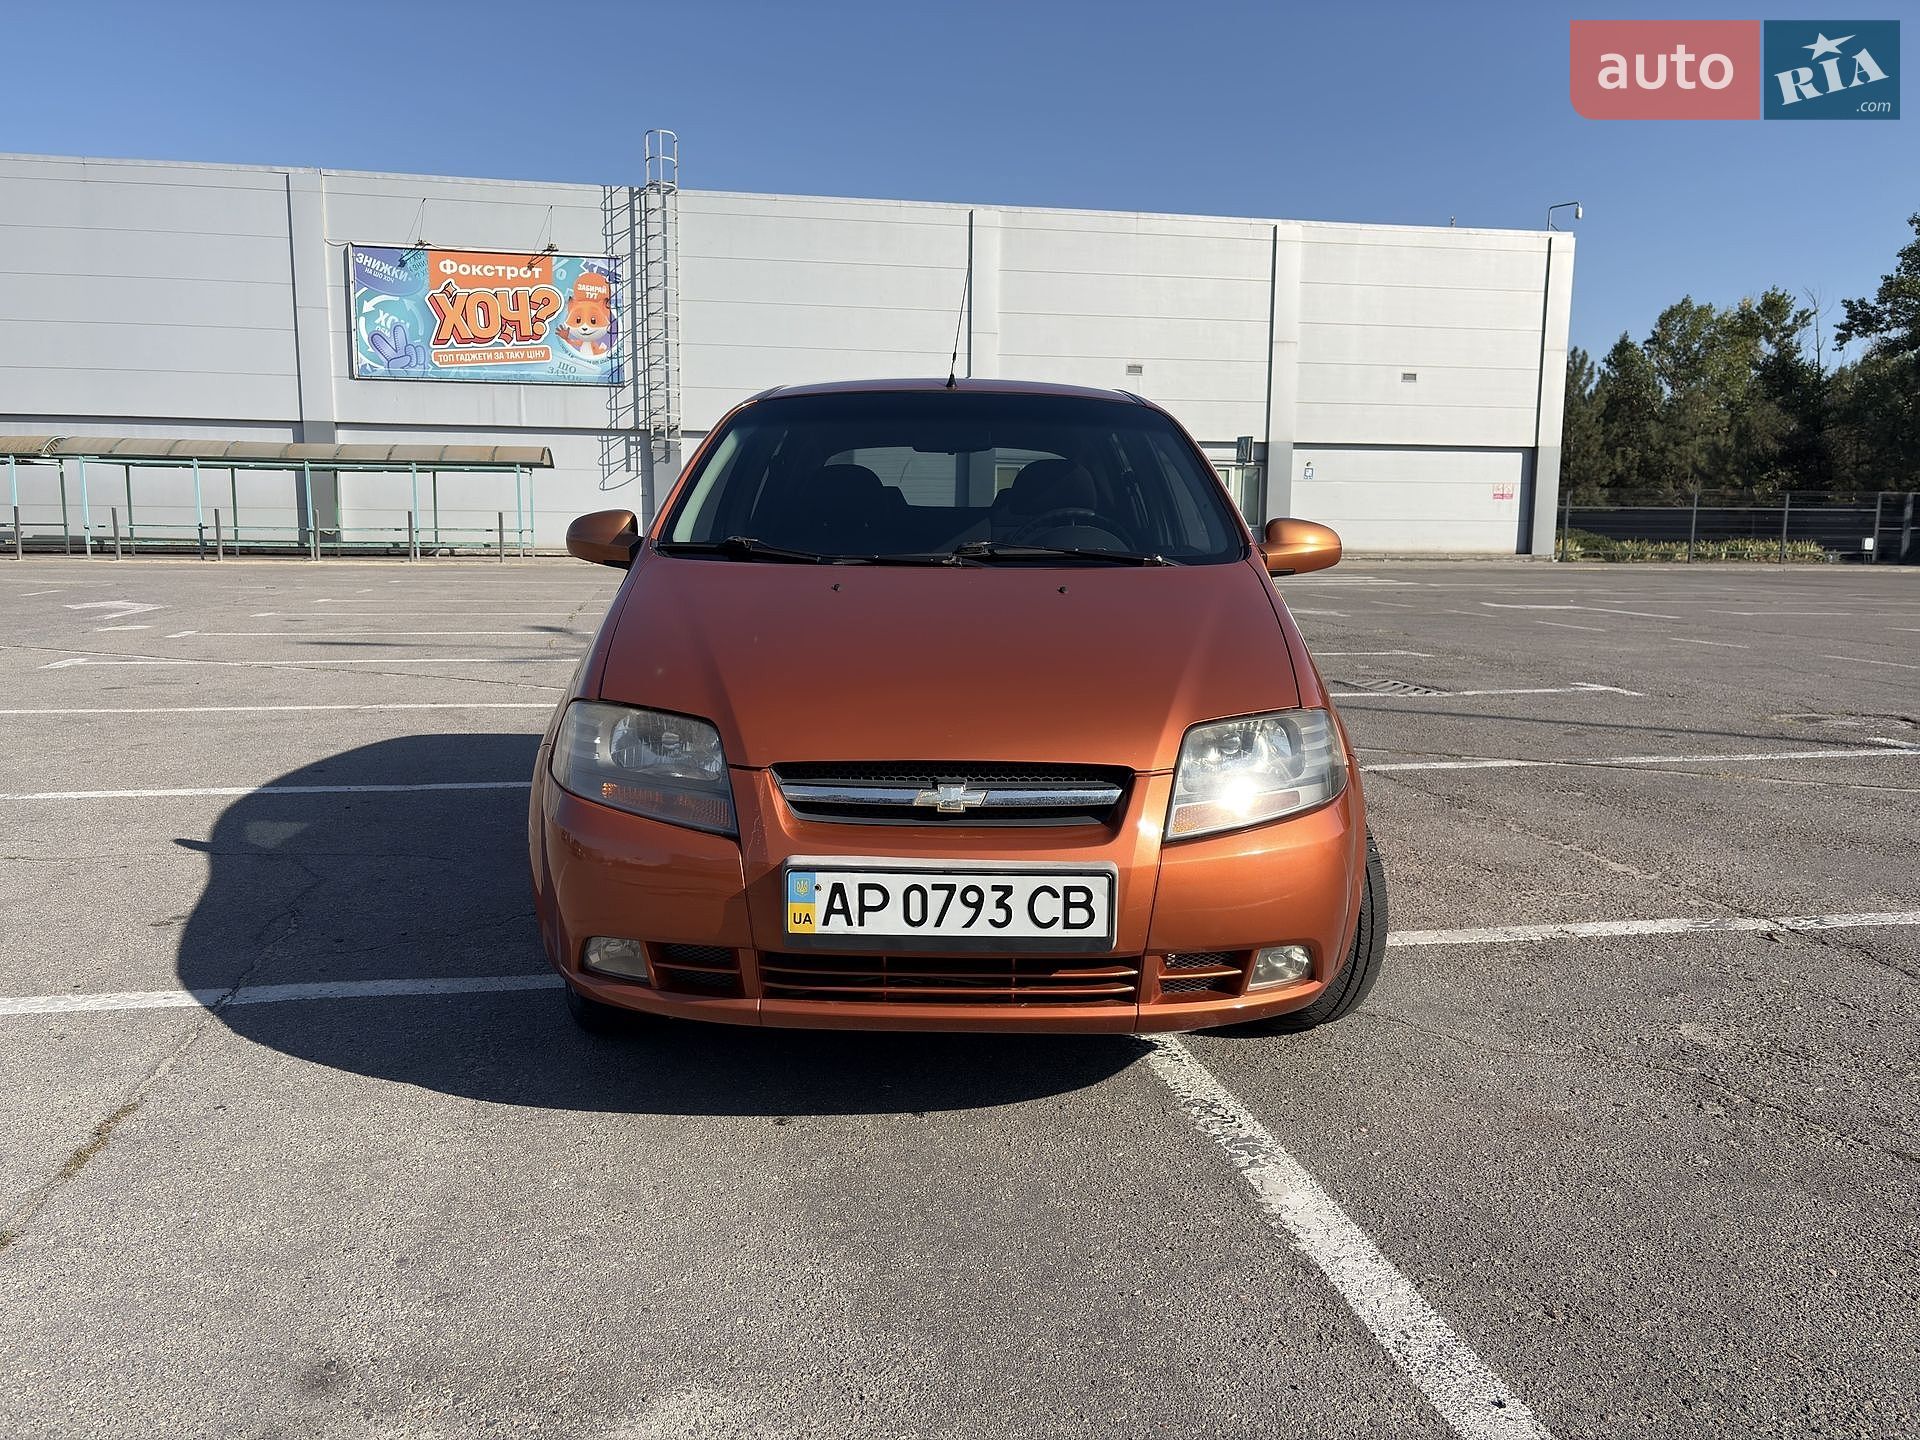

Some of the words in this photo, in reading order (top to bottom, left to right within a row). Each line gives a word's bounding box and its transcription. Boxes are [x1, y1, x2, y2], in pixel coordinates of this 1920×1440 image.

[355, 252, 408, 281] ЗНИЖКИ
[439, 259, 543, 280] Фокстрот
[577, 283, 607, 294] ЗАБИРАЙ
[586, 291, 598, 299] ТУТ
[429, 286, 562, 345] ХОЧ?
[438, 353, 454, 363] ТОП
[455, 352, 493, 362] ГАДЖЕТИ
[494, 352, 504, 360] ЗА
[506, 351, 525, 360] ТАКУ
[526, 349, 546, 360] ЦІНУ
[822, 882, 890, 927] AP
[903, 883, 1013, 928] 0793
[1027, 884, 1096, 930] CB
[793, 912, 813, 925] UA
